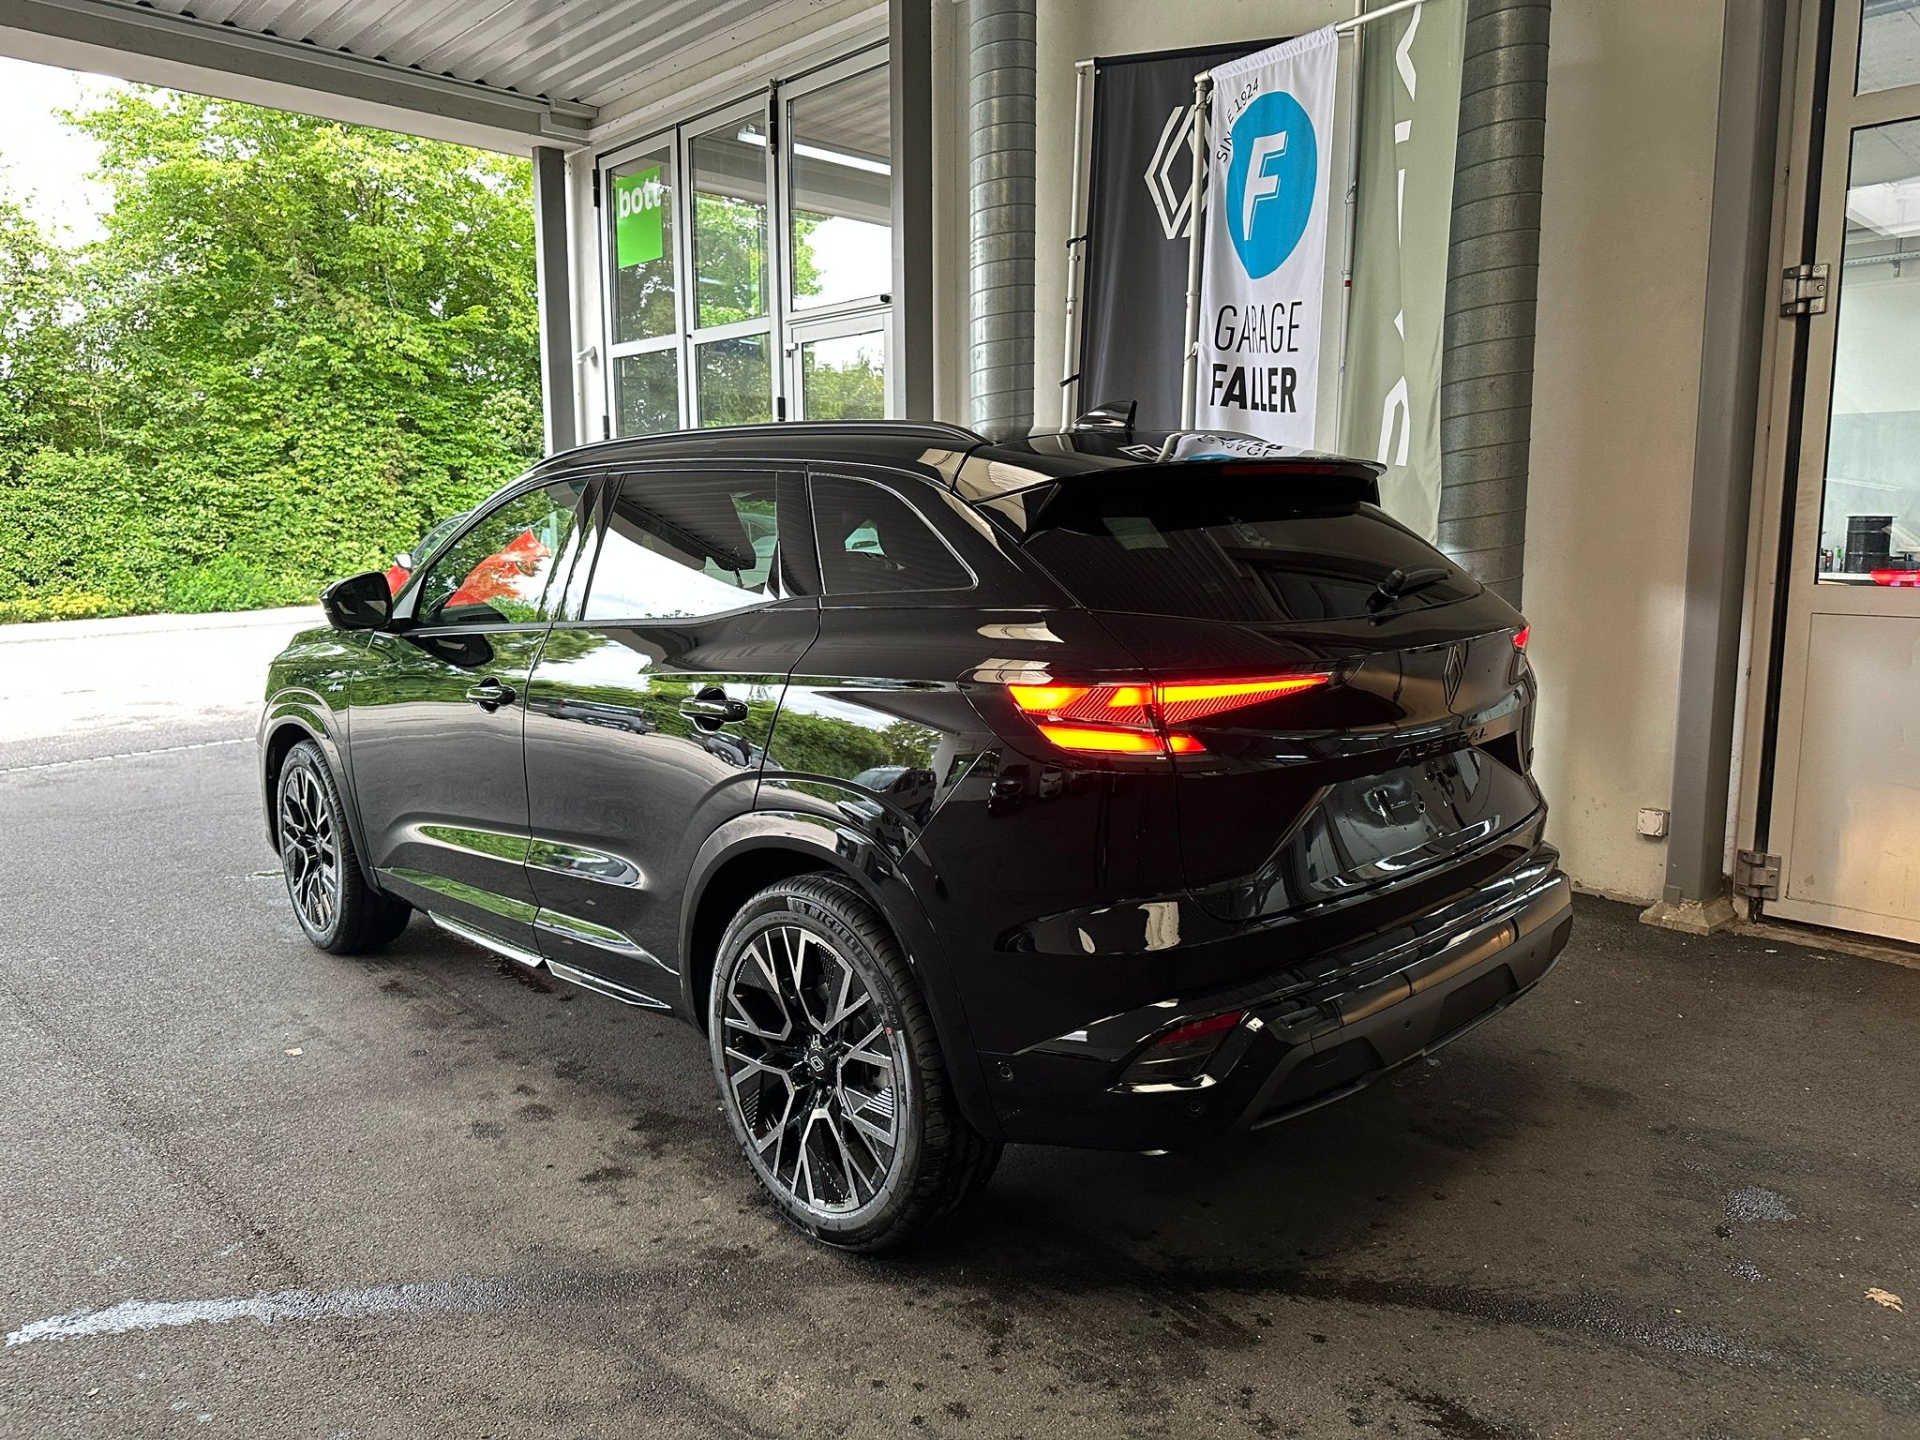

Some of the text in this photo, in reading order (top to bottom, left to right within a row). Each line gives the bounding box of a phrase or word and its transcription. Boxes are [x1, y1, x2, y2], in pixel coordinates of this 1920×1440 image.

[1217, 77, 1259, 163] SINE 1924
[619, 175, 661, 219] bott
[1243, 131, 1288, 241] F
[1214, 301, 1302, 353] GARAGE
[1210, 363, 1297, 413] FALLER
[808, 905, 874, 968] MICHELIN
